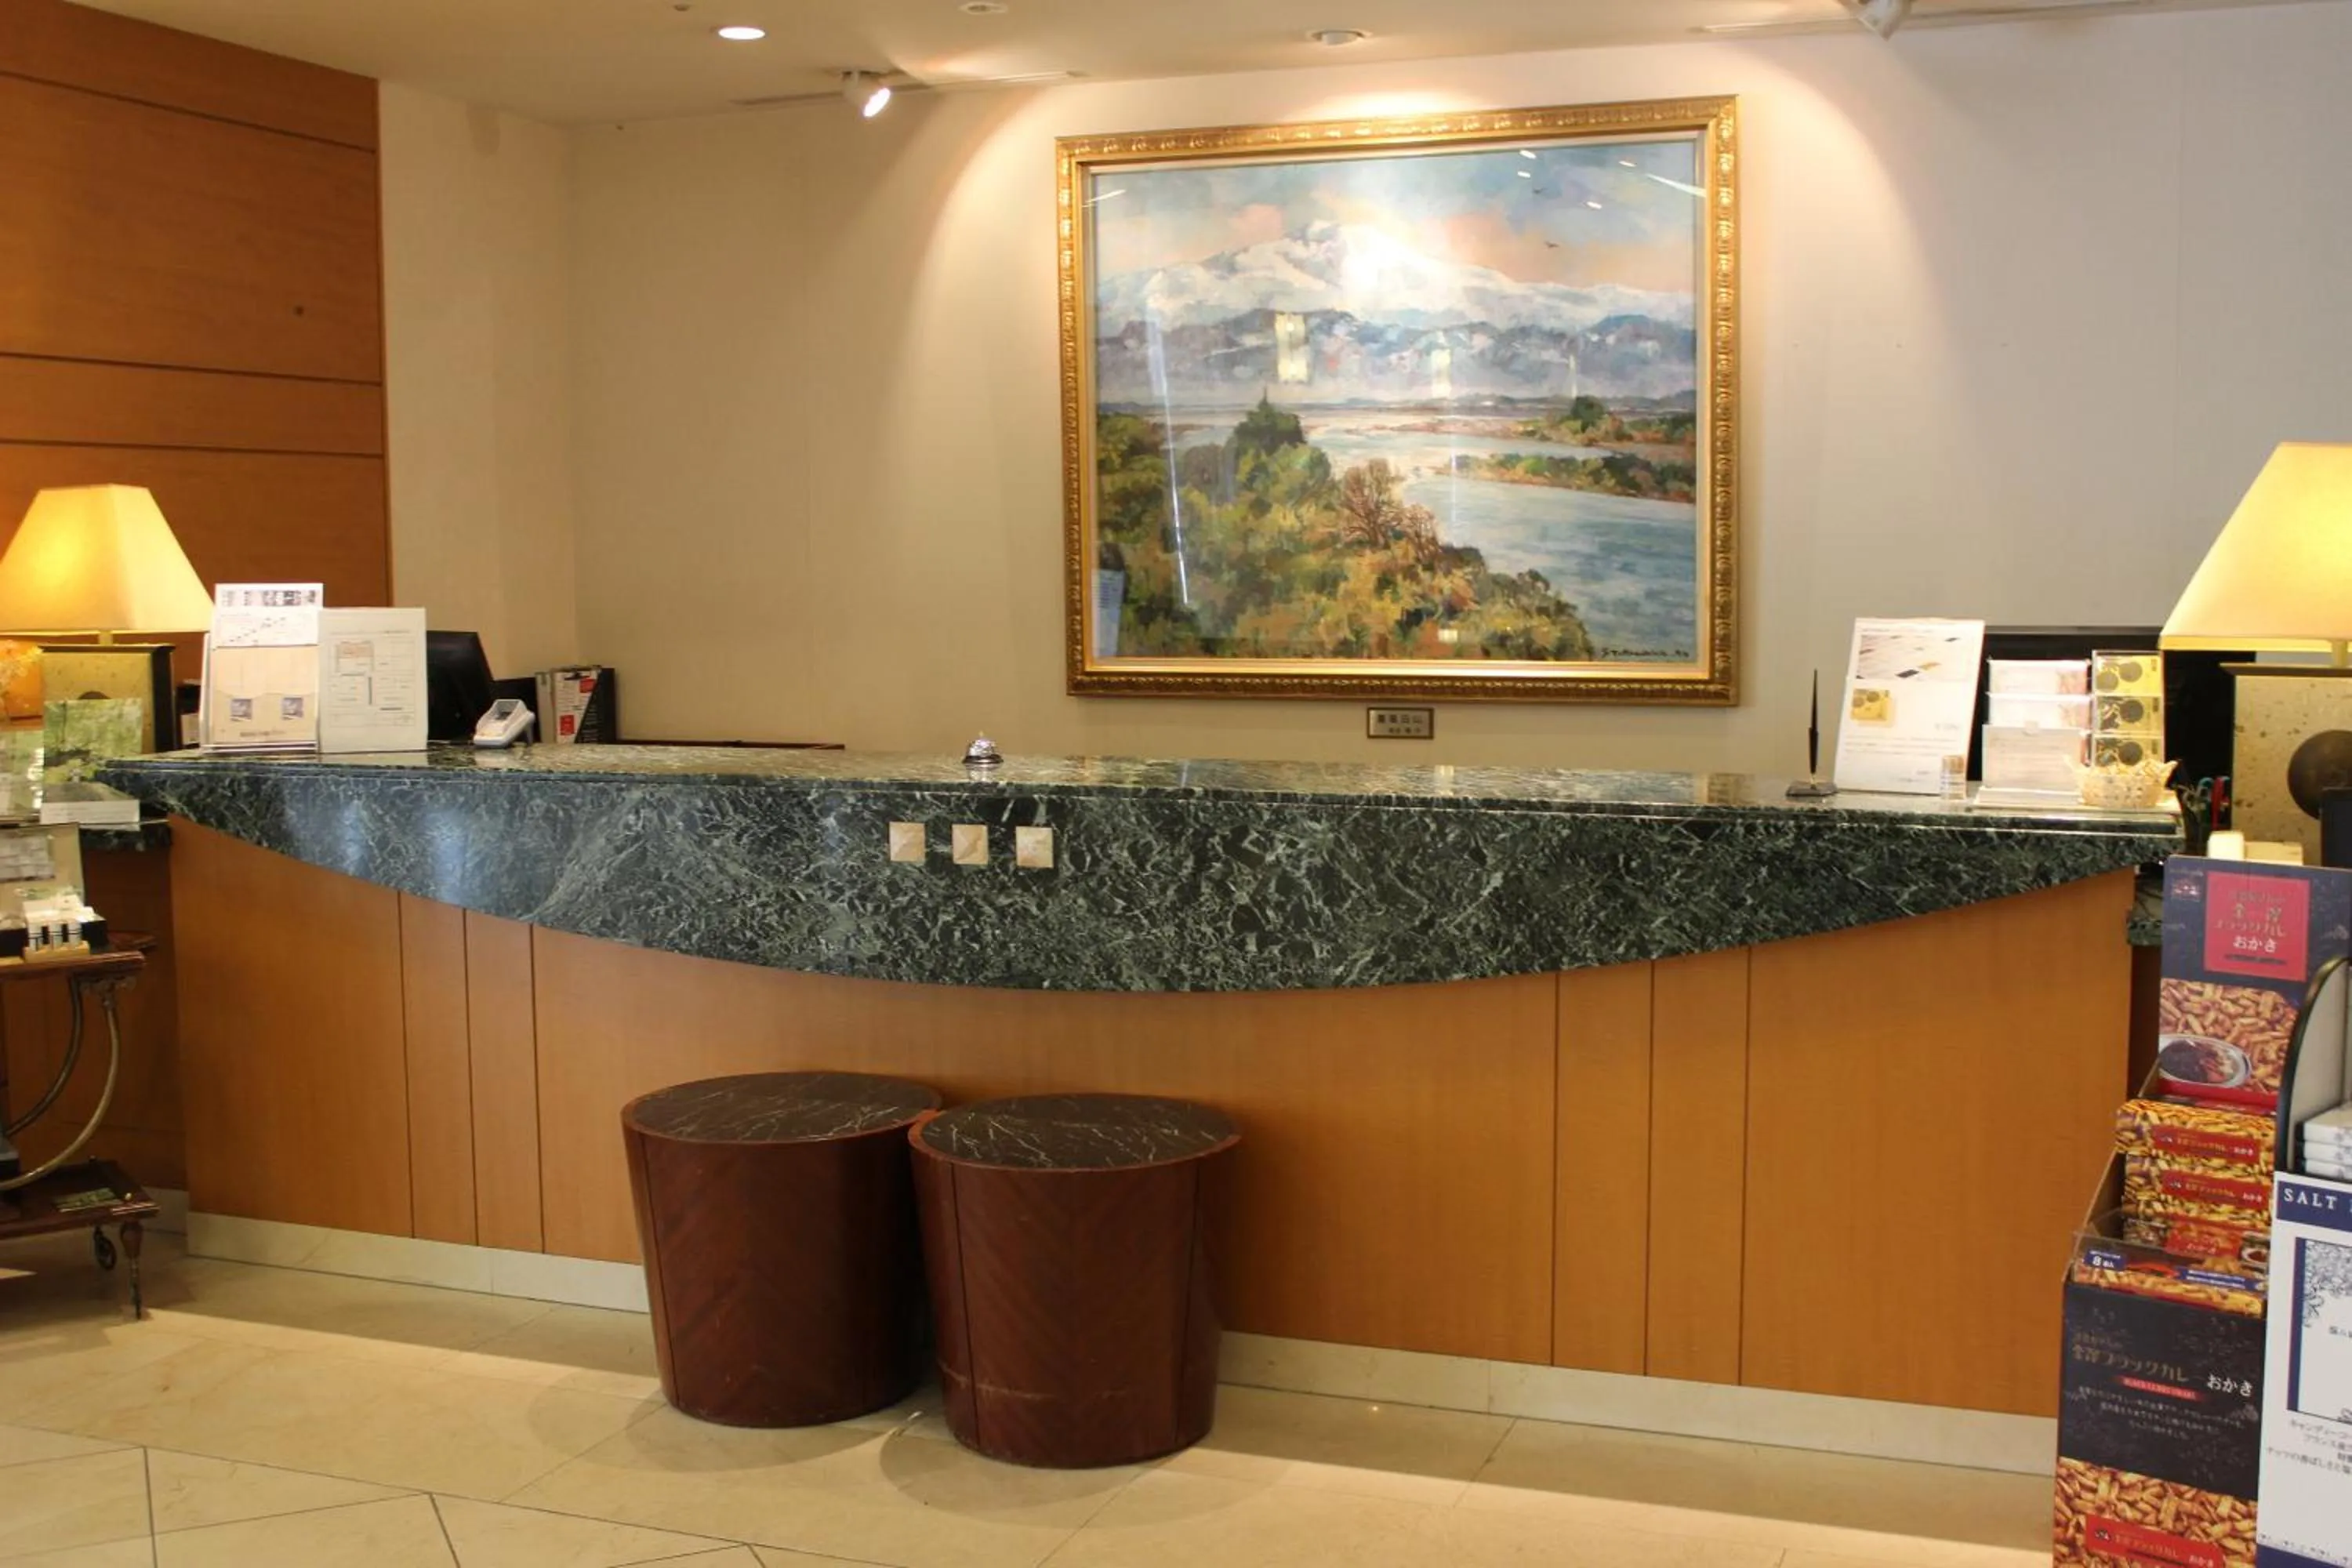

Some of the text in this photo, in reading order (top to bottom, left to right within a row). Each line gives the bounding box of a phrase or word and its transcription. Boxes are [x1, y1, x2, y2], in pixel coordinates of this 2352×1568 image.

[2233, 935, 2278, 953] おかき
[2283, 1188, 2338, 1210] SALT
[2206, 1374, 2253, 1397] おかき
